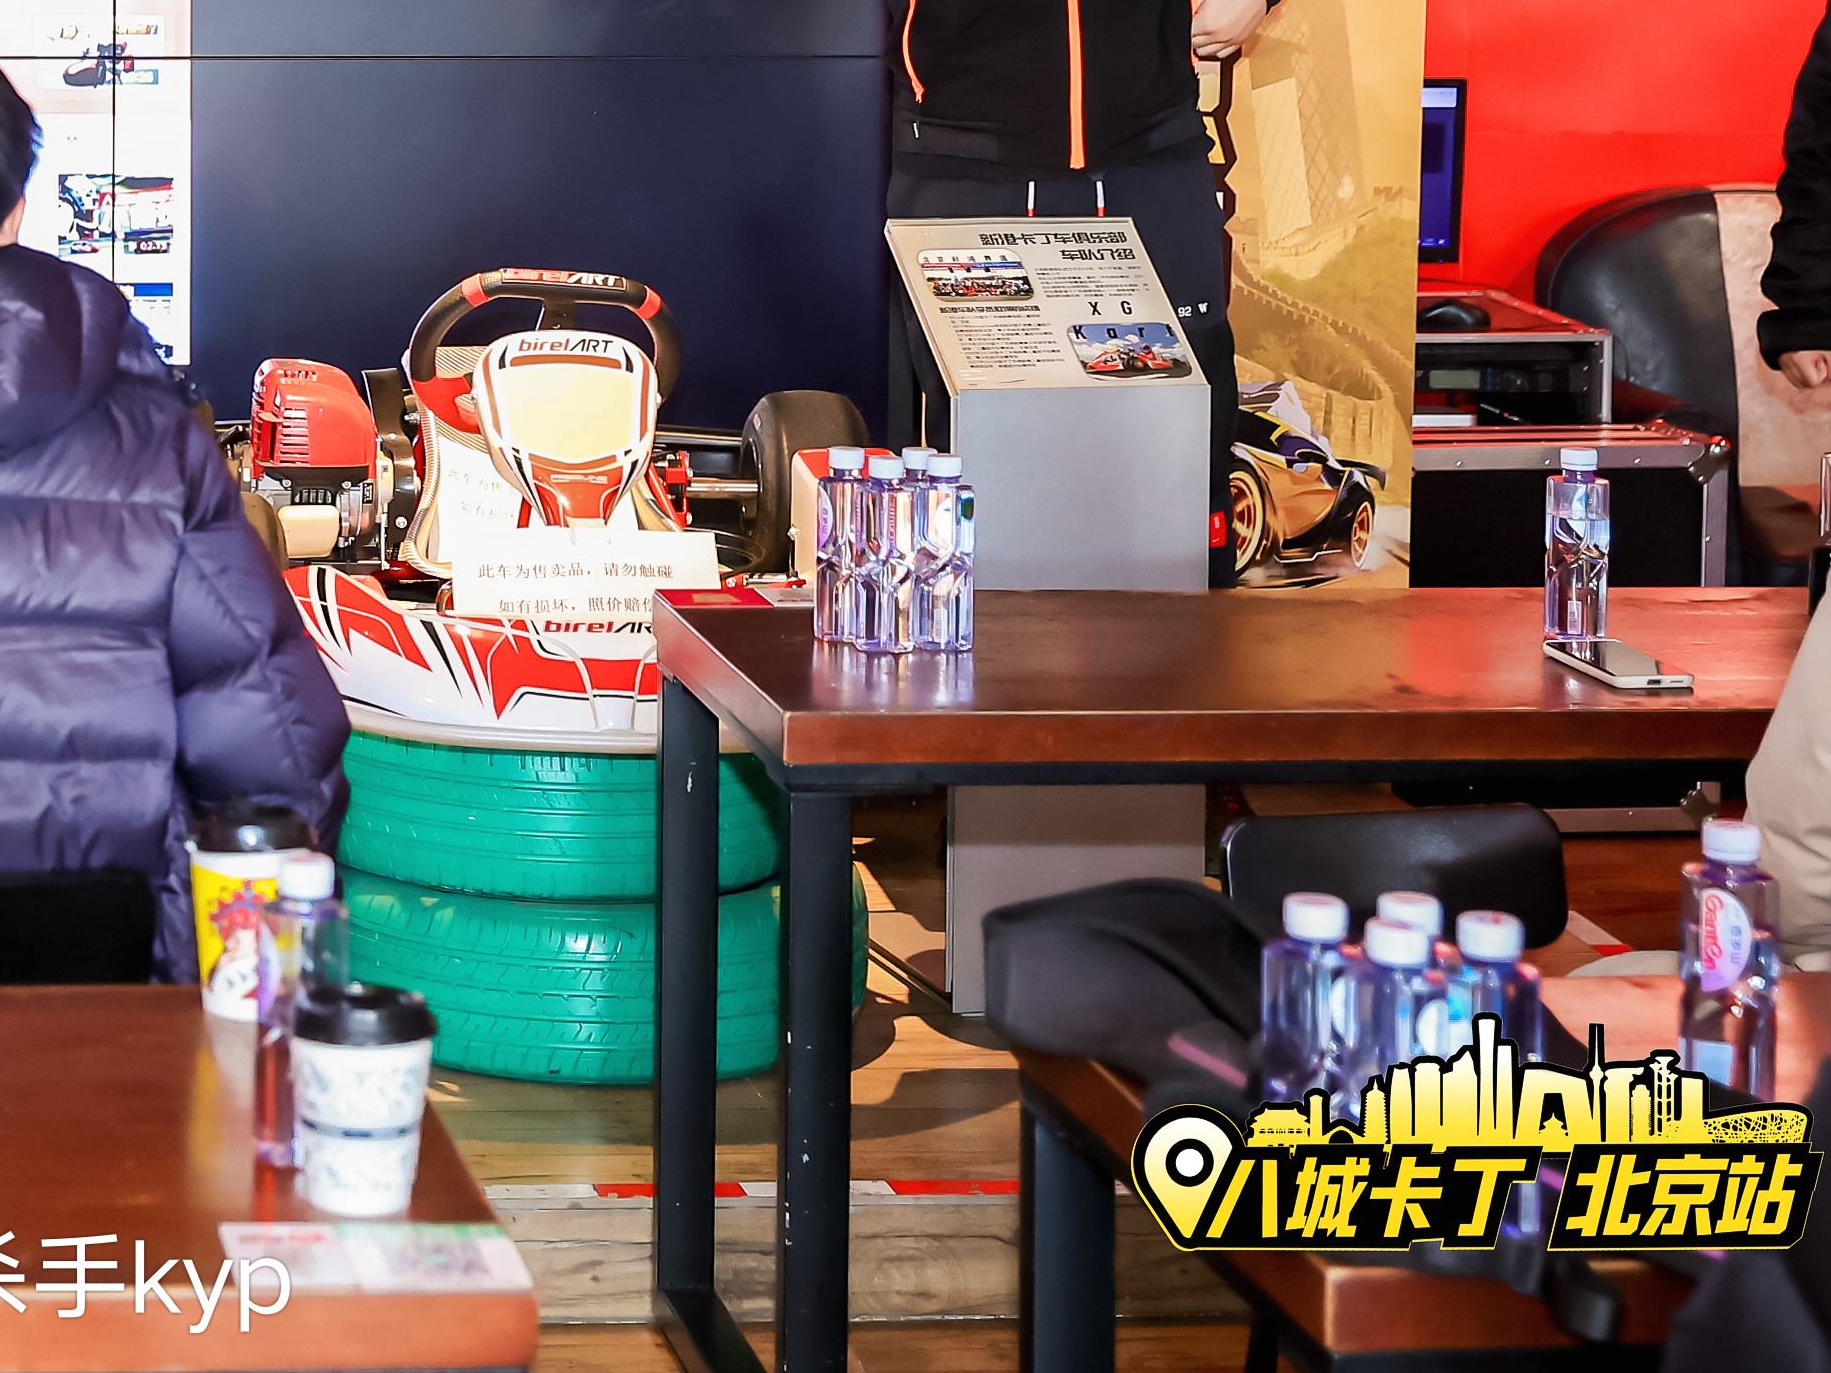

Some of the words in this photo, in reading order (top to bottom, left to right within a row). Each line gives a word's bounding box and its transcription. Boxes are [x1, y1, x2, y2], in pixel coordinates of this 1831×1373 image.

[1177, 305, 1193, 318] 92
[518, 338, 614, 354] birelART
[478, 561, 674, 579] 此车为售卖品，请勿触碰
[544, 620, 654, 634] birelAR
